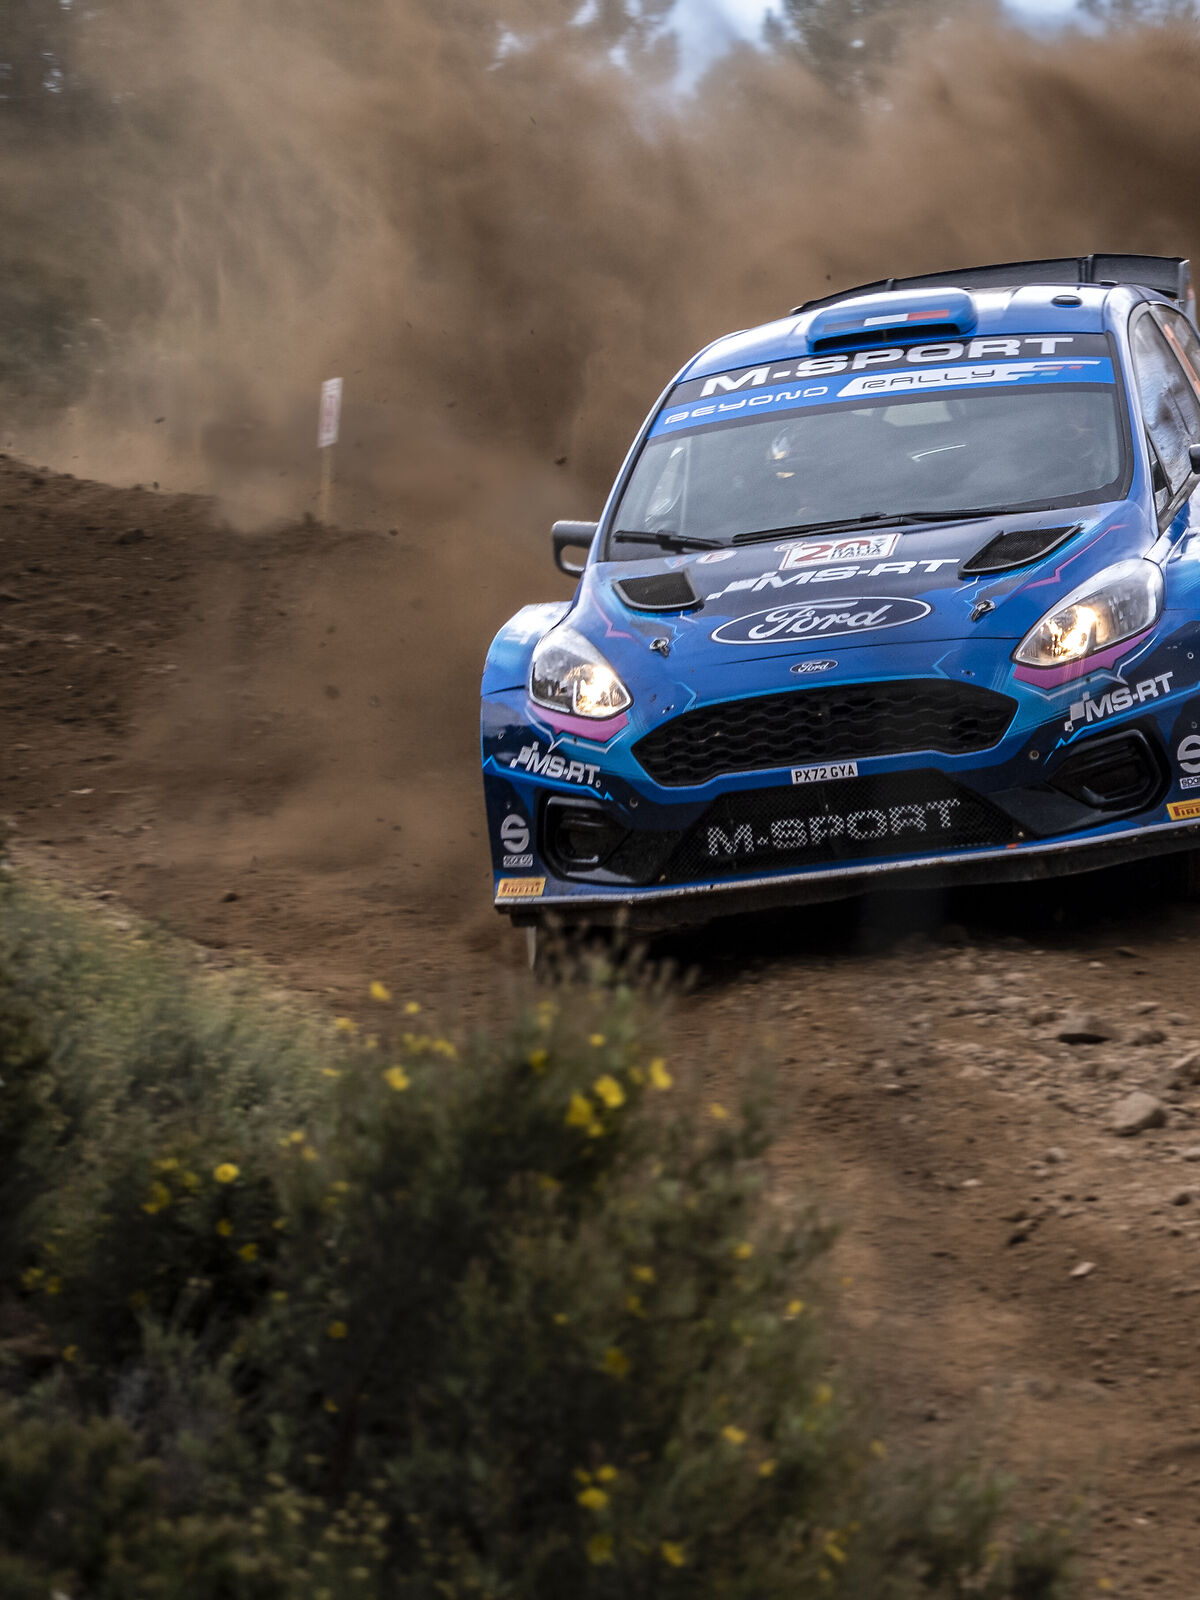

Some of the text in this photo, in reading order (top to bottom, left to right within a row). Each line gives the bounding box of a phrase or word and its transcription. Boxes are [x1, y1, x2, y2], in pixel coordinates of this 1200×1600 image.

[699, 337, 1075, 397] M-SPORT
[664, 369, 997, 425] BEYOND RALLY
[750, 558, 961, 592] MS-RT
[747, 601, 894, 640] Ford
[797, 660, 830, 673] Ford
[1085, 671, 1174, 722] MS-RT
[525, 751, 601, 785] MS-RT
[795, 764, 855, 782] PX72 GYA
[706, 798, 961, 856] M-SPORT
